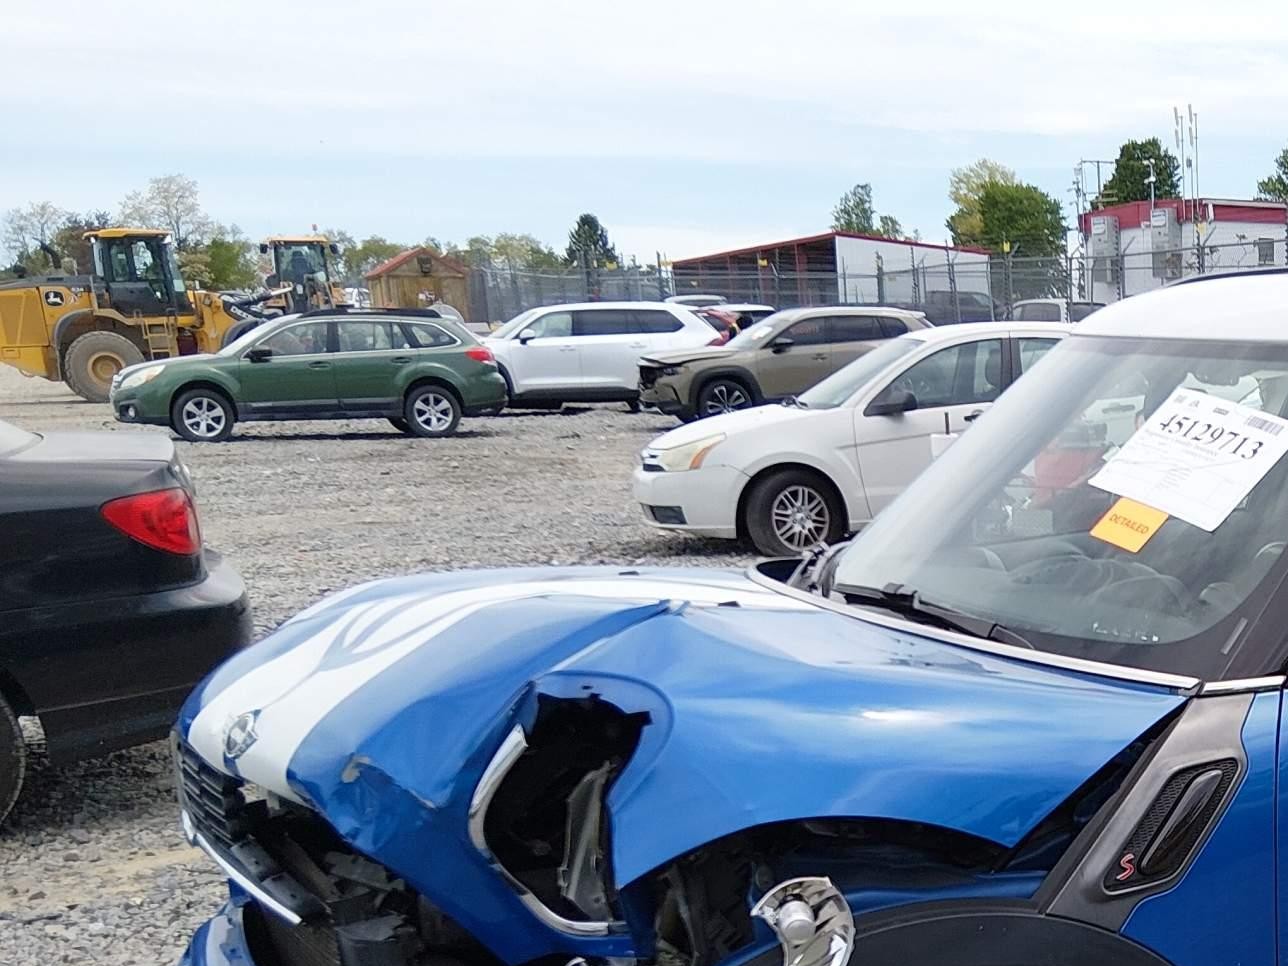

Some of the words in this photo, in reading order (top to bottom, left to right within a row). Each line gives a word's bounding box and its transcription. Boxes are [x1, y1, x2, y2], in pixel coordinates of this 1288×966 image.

[1160, 413, 1265, 460] 45129713
[1108, 512, 1150, 535] DETAILED
[1116, 853, 1135, 881] S
